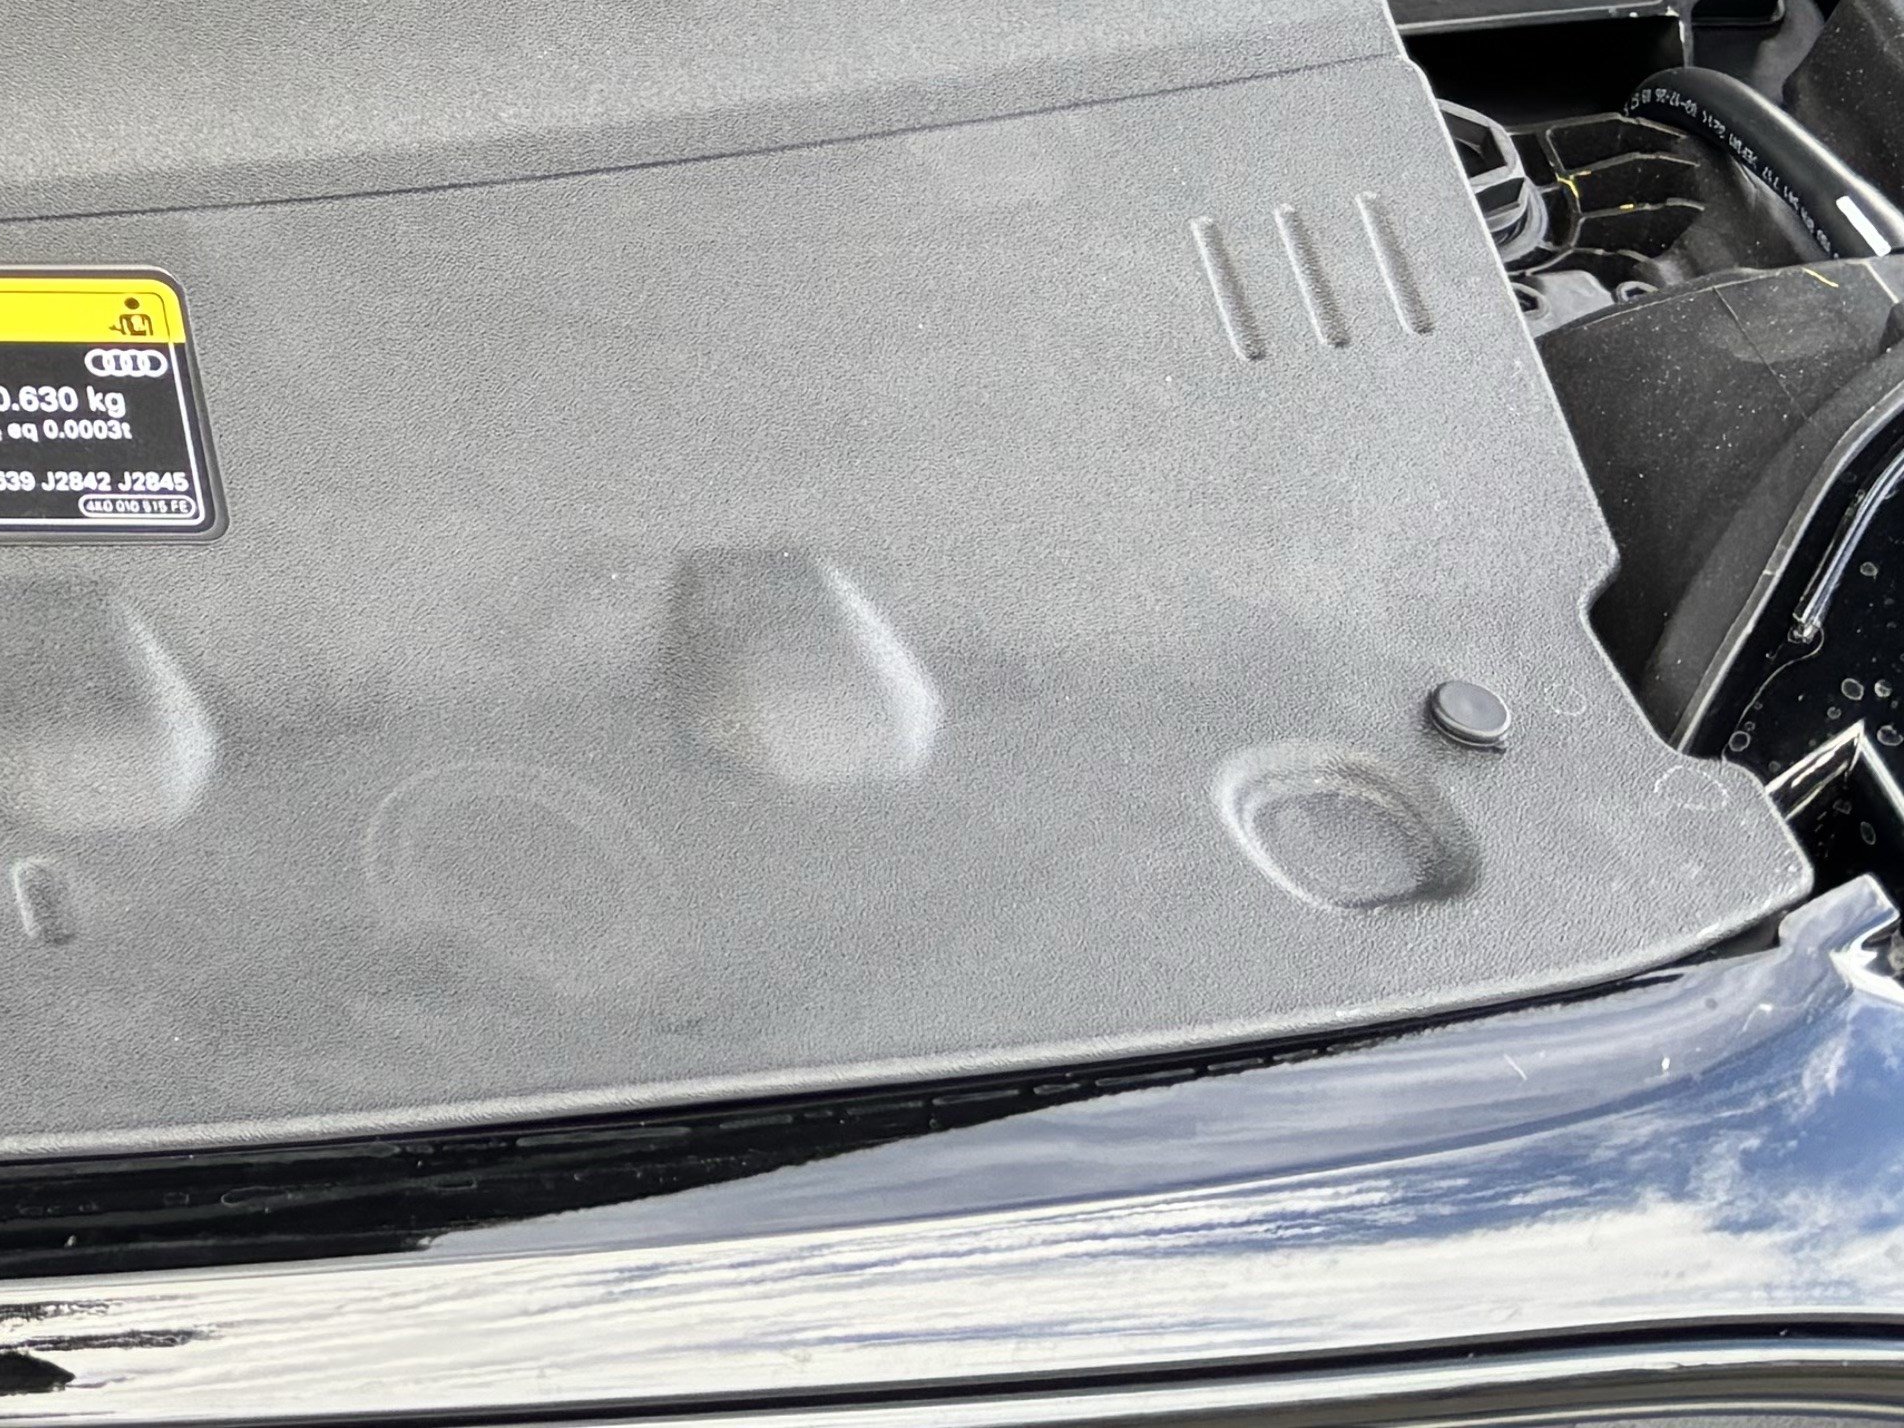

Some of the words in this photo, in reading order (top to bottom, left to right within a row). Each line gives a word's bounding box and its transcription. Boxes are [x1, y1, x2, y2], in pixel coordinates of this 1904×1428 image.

[87, 385, 127, 418] kg
[6, 421, 40, 444] eq
[42, 419, 132, 440] 0.0003t
[41, 471, 112, 493] J2842
[117, 471, 188, 493] J2845
